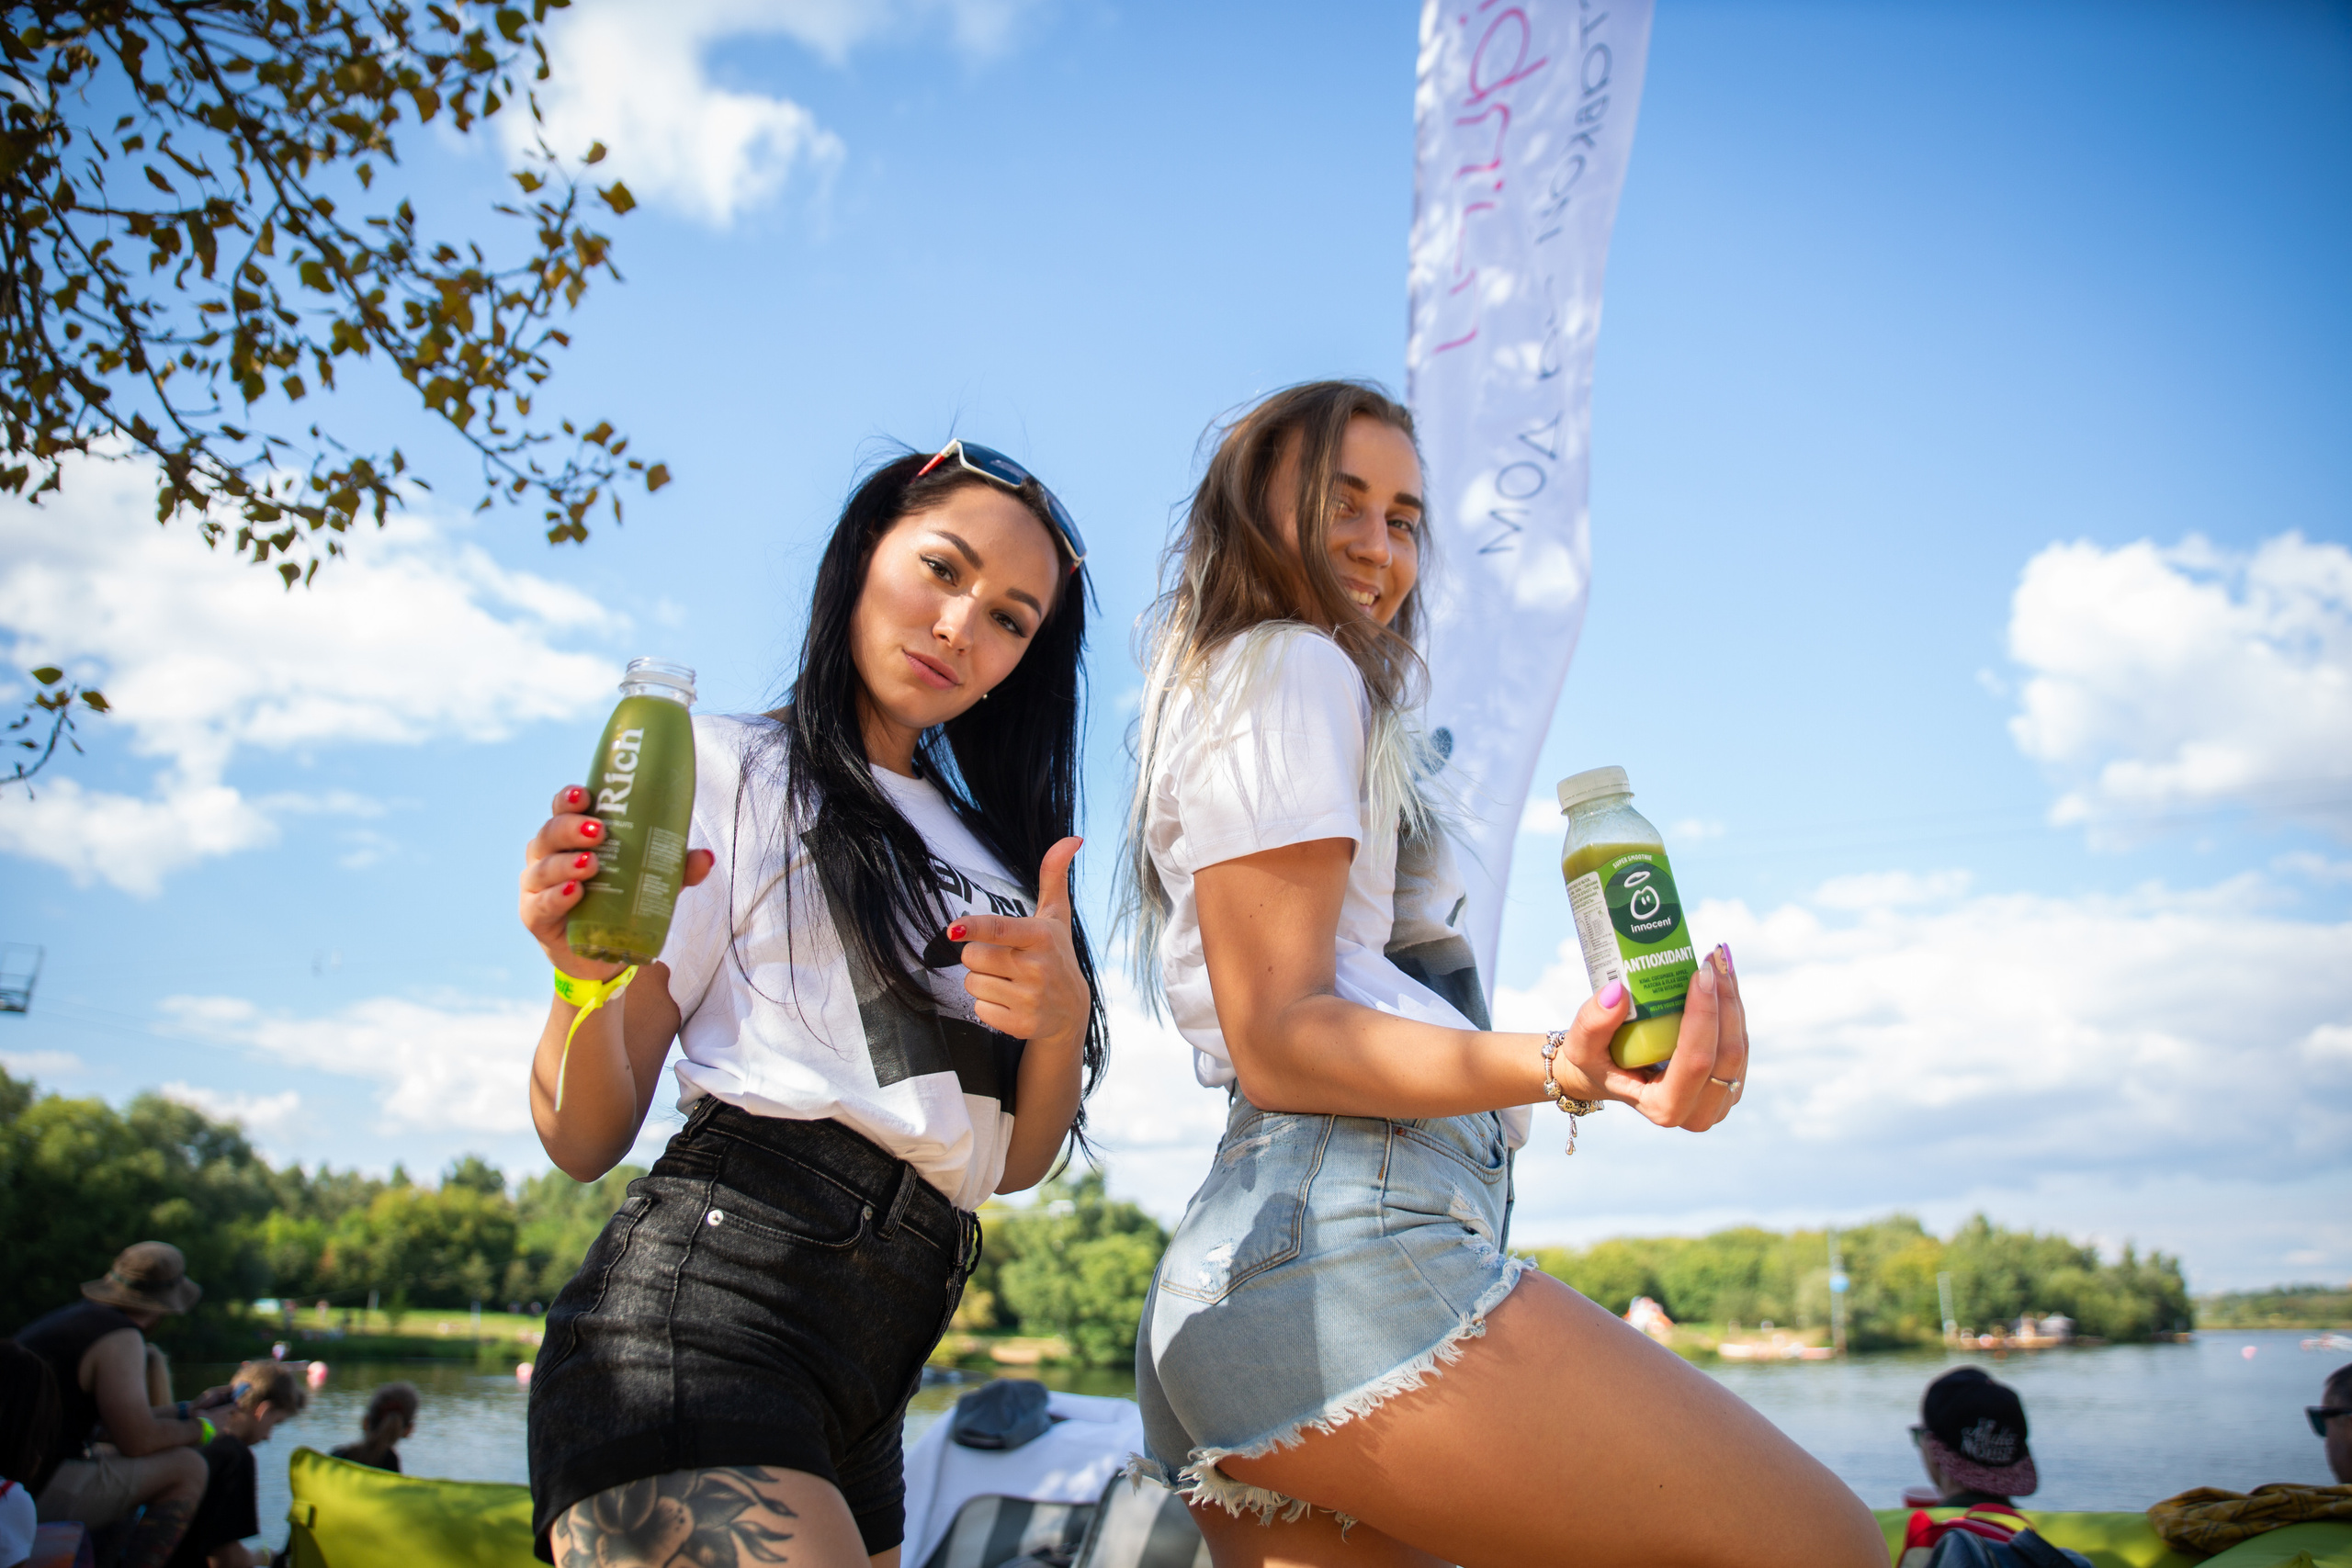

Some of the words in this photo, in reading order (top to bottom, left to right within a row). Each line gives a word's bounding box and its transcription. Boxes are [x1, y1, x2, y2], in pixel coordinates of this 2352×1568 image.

[1612, 856, 1627, 869] SUPER
[1627, 853, 1653, 862] SMOOTHIE
[1630, 916, 1671, 933] innocent
[1623, 945, 1693, 974] ANTIOXIDANT
